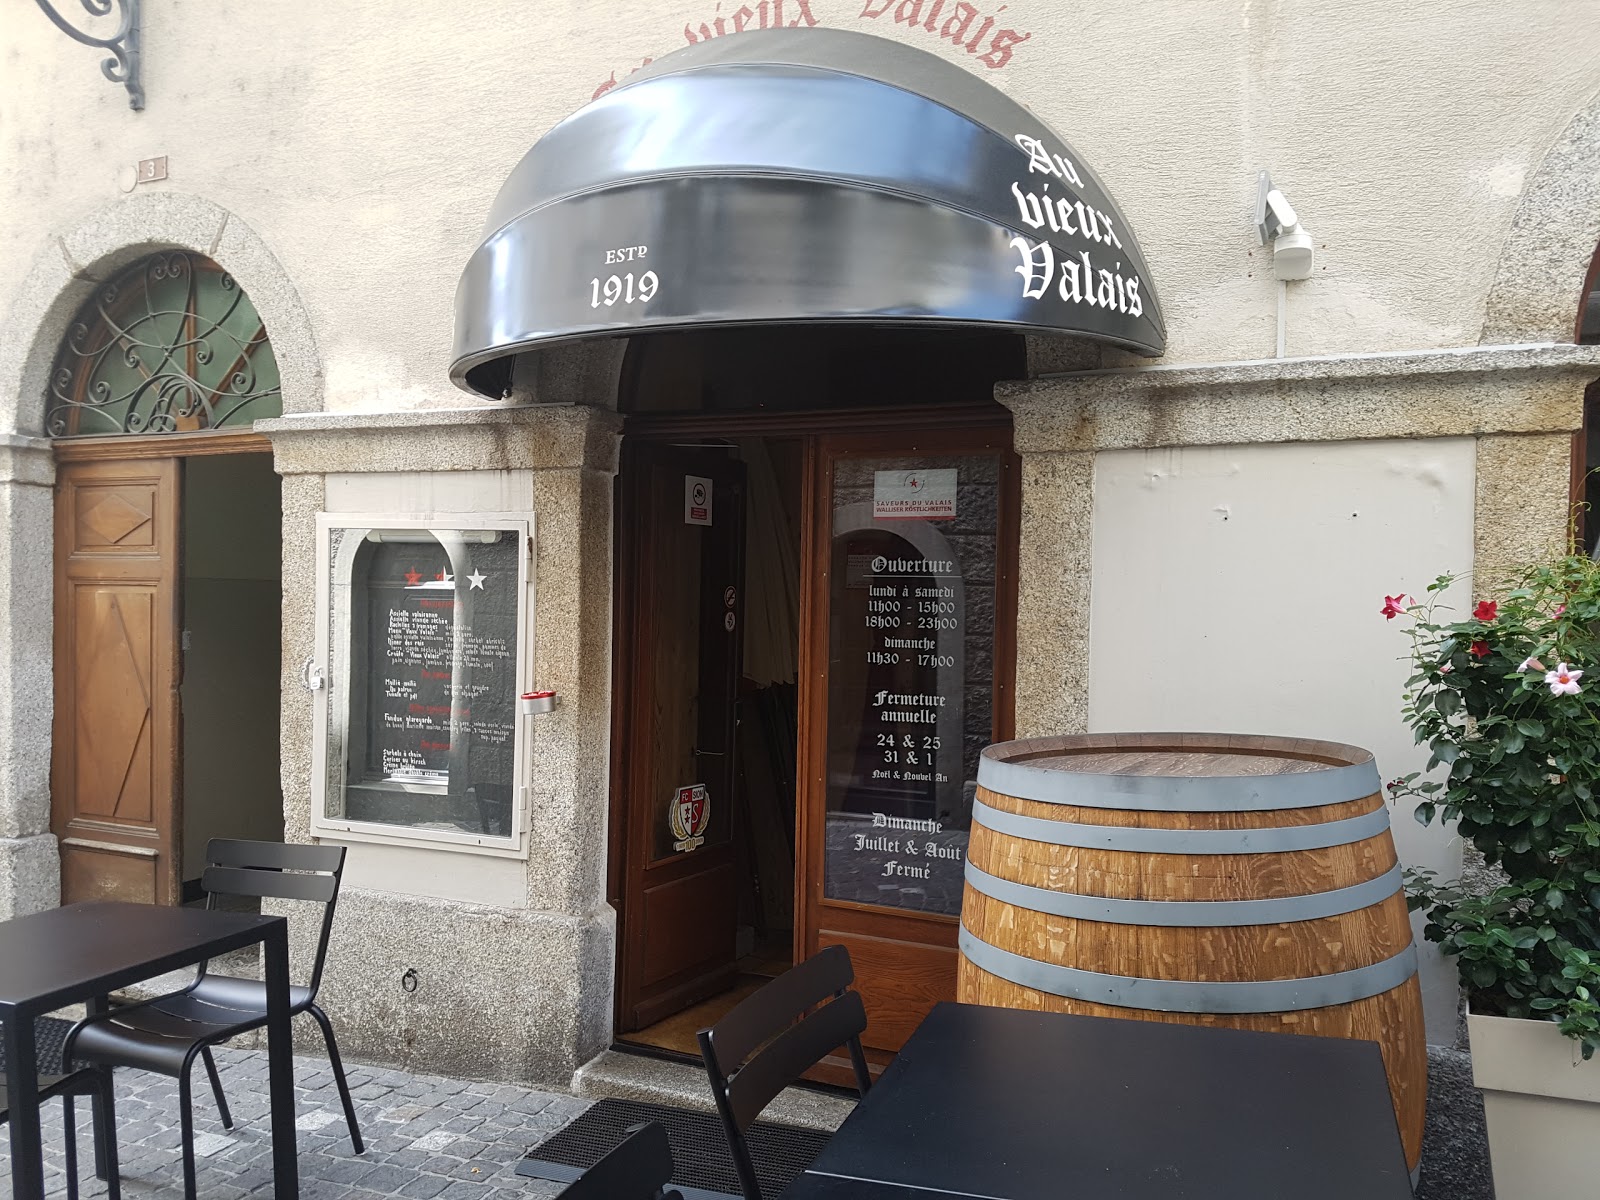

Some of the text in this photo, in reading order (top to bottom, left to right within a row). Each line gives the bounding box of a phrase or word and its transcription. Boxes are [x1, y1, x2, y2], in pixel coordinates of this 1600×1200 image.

[147, 161, 155, 177] 3
[1014, 133, 1085, 189] Au
[1011, 181, 1123, 250] vieux
[1009, 236, 1143, 318] Valais
[590, 270, 659, 309] 1919
[871, 555, 953, 573] Ouverture
[869, 585, 955, 598] lundi à samedi
[868, 600, 901, 614] 11h00
[918, 601, 955, 615] 15h00
[865, 616, 901, 629] 18h00
[917, 617, 958, 631] 23h00
[884, 636, 936, 651] dimanche
[866, 652, 900, 666] 11h30
[917, 654, 955, 668] 17h00
[872, 690, 946, 706] Fermeture
[881, 709, 937, 724] annuelle
[876, 733, 941, 750] 24 & 25
[884, 750, 932, 766] 31 & 1
[871, 769, 948, 783] Noël & Nouvel An
[682, 792, 688, 801] FC
[872, 812, 943, 835] Dimanche
[854, 834, 961, 860] Juillet & Août
[881, 860, 931, 879] Fermé
